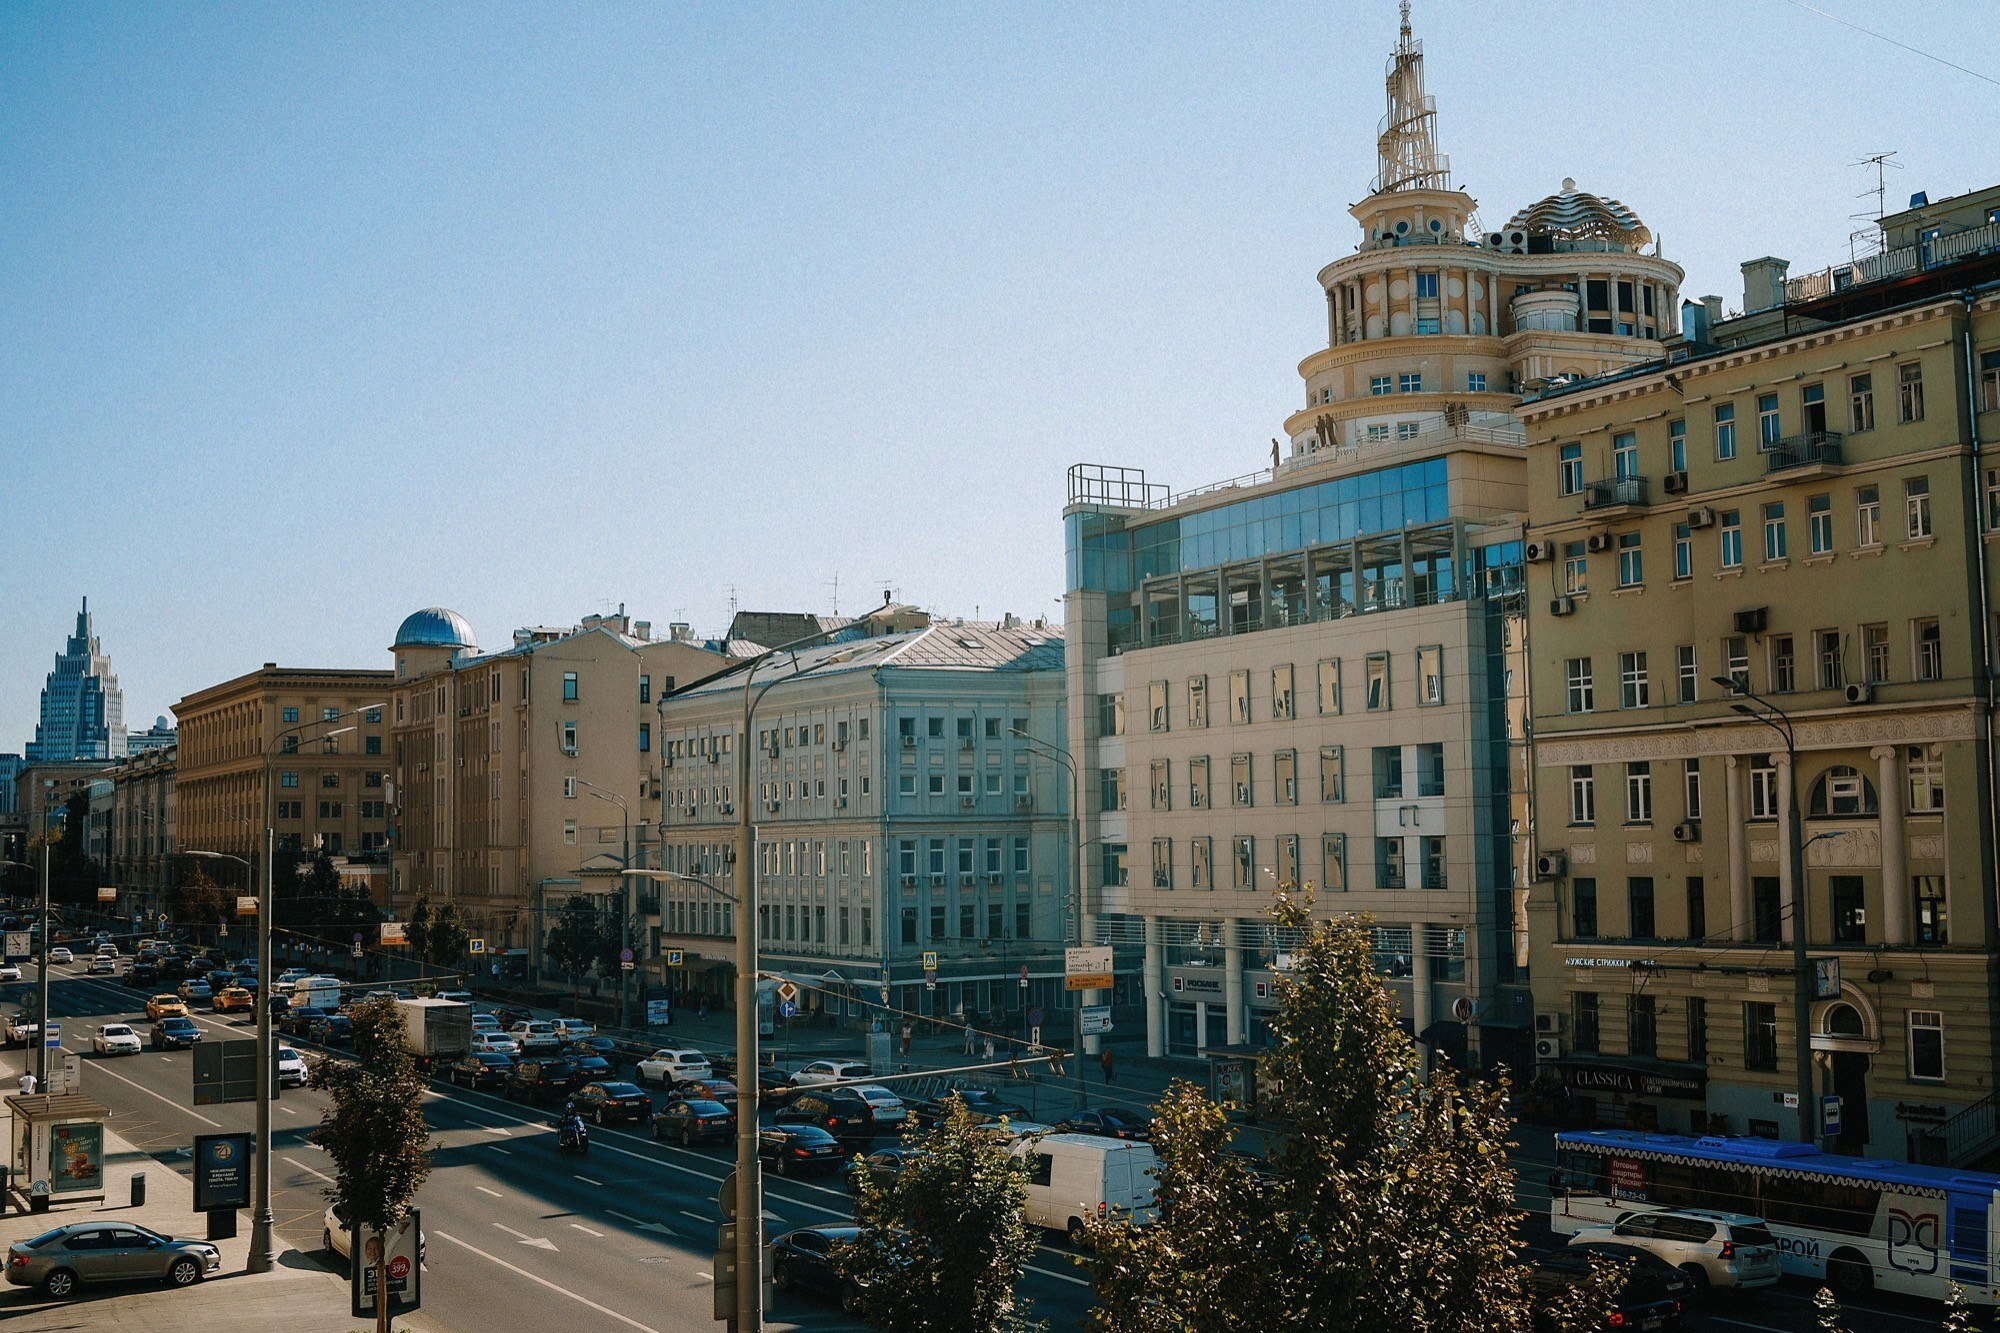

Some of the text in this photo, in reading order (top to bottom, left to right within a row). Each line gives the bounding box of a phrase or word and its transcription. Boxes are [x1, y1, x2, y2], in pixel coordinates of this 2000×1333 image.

[1566, 958, 1594, 966] МУЖСКИЕ
[1596, 959, 1624, 967] СТРИЖКИ
[1187, 980, 1220, 988] РОСБАНК
[1576, 1070, 1633, 1090] CLASSICA
[1647, 1085, 1662, 1094] БУТИК
[1613, 1160, 1638, 1170] Готовые
[1613, 1170, 1642, 1179] квартиры
[1618, 1177, 1641, 1187] Москве
